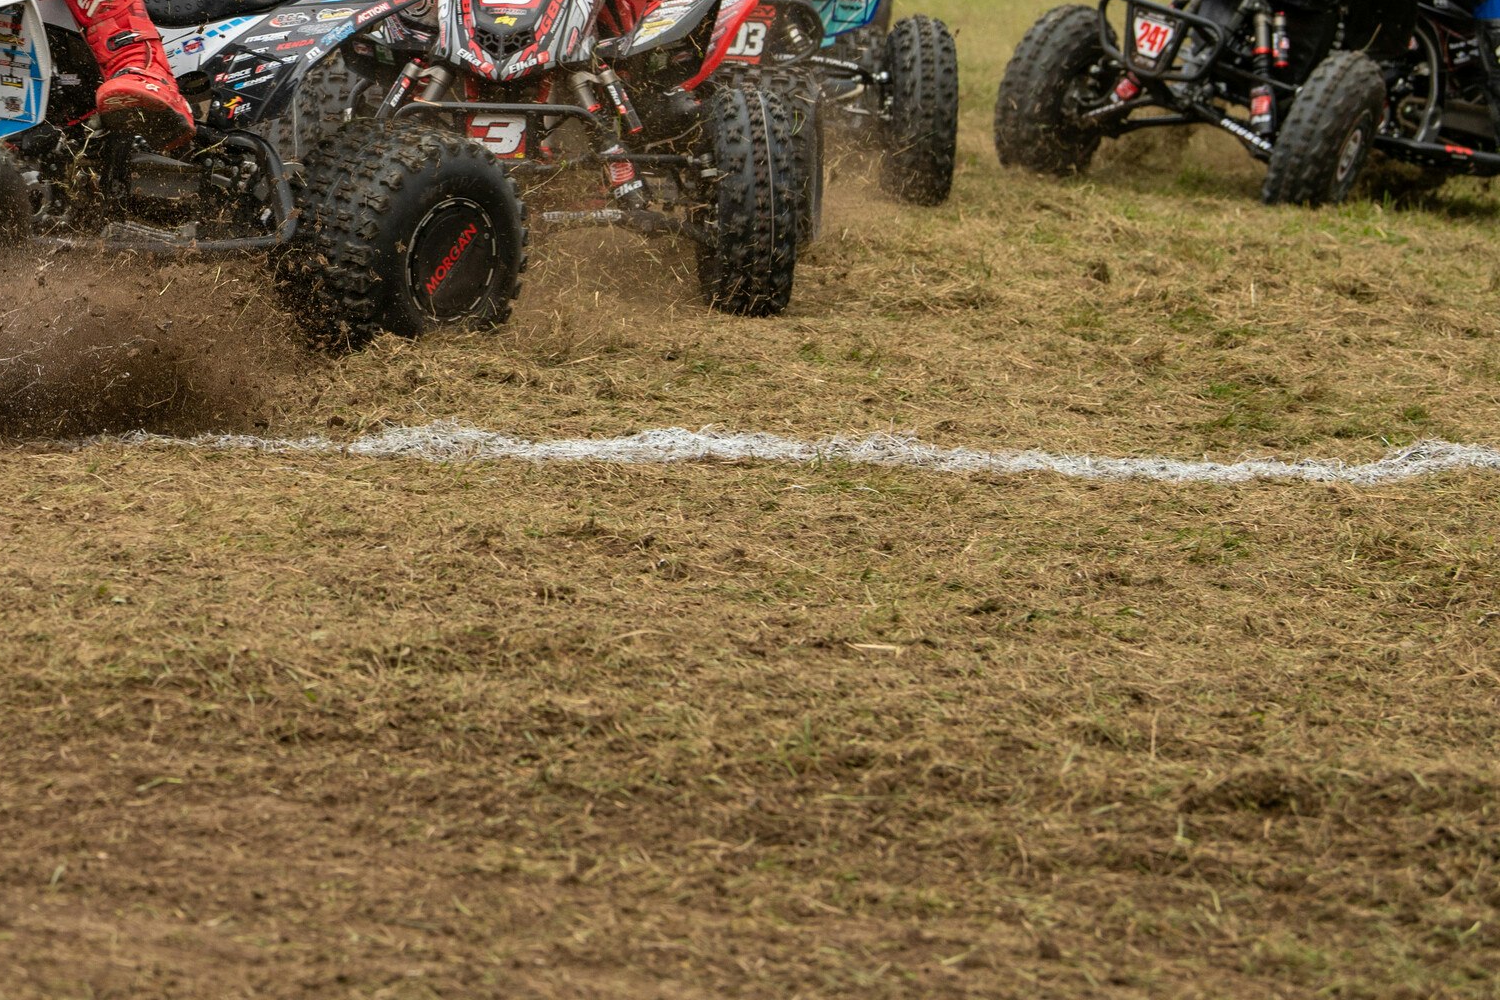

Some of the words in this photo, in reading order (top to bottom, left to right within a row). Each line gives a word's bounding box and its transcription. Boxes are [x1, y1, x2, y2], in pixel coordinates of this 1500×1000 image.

[276, 38, 316, 51] KENDA
[1135, 20, 1171, 55] 241
[456, 47, 482, 68] Elka
[508, 56, 539, 75] Elka
[608, 85, 622, 107] Elka
[470, 113, 528, 155] 3
[613, 178, 644, 200] Elka
[425, 222, 479, 295] MORGAN
